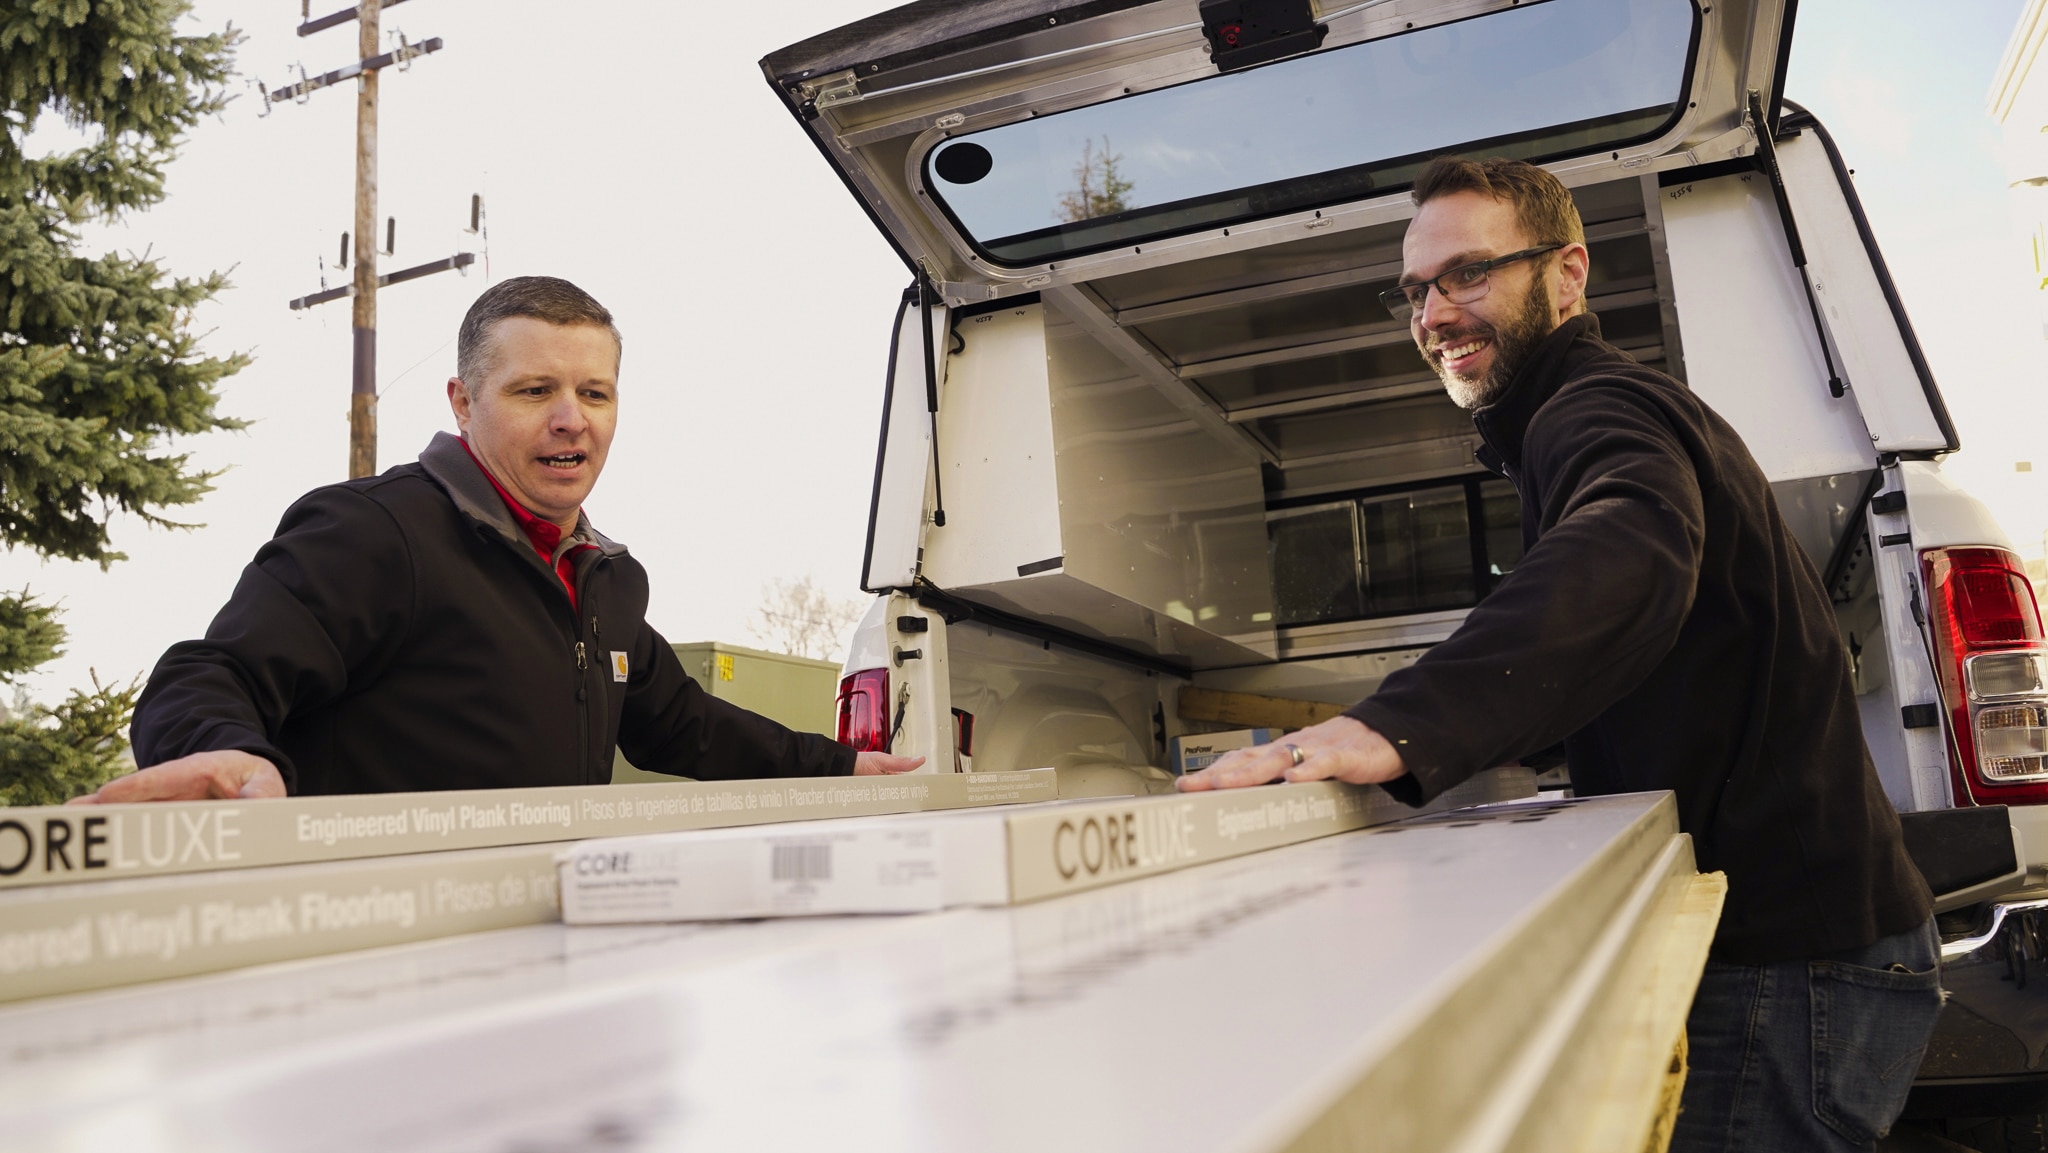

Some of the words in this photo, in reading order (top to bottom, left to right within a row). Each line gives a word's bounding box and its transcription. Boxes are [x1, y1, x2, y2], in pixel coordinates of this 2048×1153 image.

[298, 812, 408, 844] Engineered
[412, 807, 457, 836] Vinyl
[460, 804, 507, 828] Plank
[510, 800, 571, 827] Flooring
[582, 798, 615, 820] Pisos
[618, 797, 633, 817] de
[691, 793, 705, 811] de
[745, 790, 758, 808] de
[789, 786, 826, 807] Plancher
[877, 783, 900, 801] lames
[901, 785, 910, 800] en
[911, 783, 930, 801] vinyle
[1053, 803, 1197, 880] CORELUXE
[1217, 808, 1265, 841] Engineered
[97, 905, 193, 962] Vinyl
[199, 895, 293, 945] Plank
[301, 887, 413, 932] Flooring
[435, 877, 495, 914] Pisos
[498, 872, 526, 906] de
